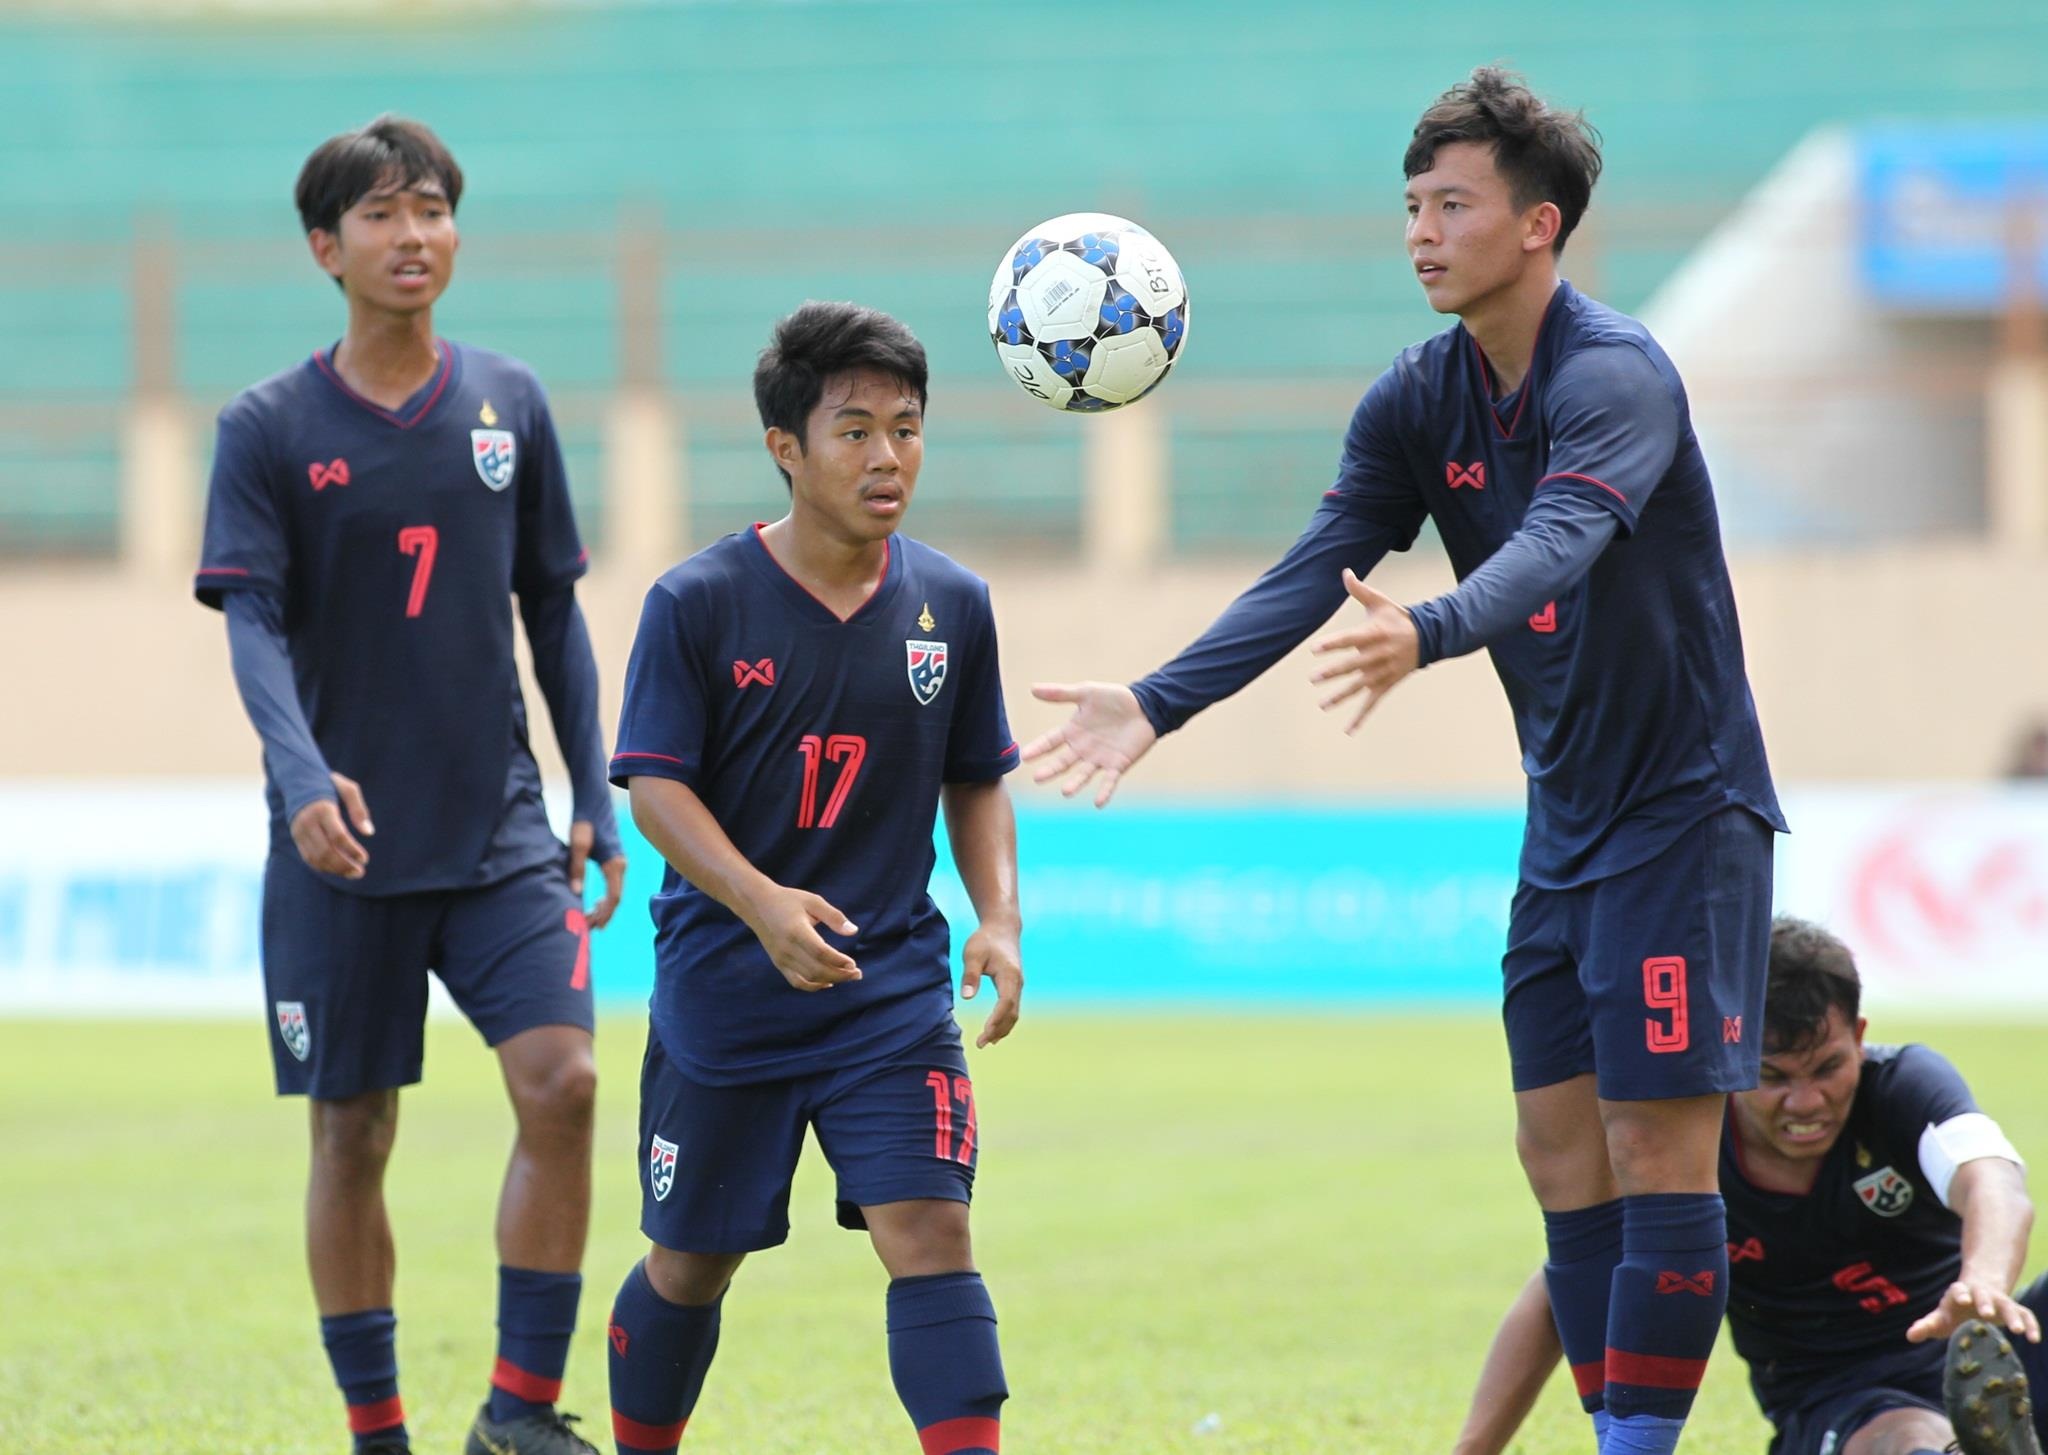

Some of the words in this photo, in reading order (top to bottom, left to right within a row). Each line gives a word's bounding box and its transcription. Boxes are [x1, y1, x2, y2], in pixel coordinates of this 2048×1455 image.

[398, 525, 438, 618] 7
[797, 734, 867, 829] 17
[565, 908, 590, 991] 7
[1642, 955, 1689, 1053] 9
[925, 1071, 976, 1166] 17
[1832, 1261, 1909, 1314] 5
